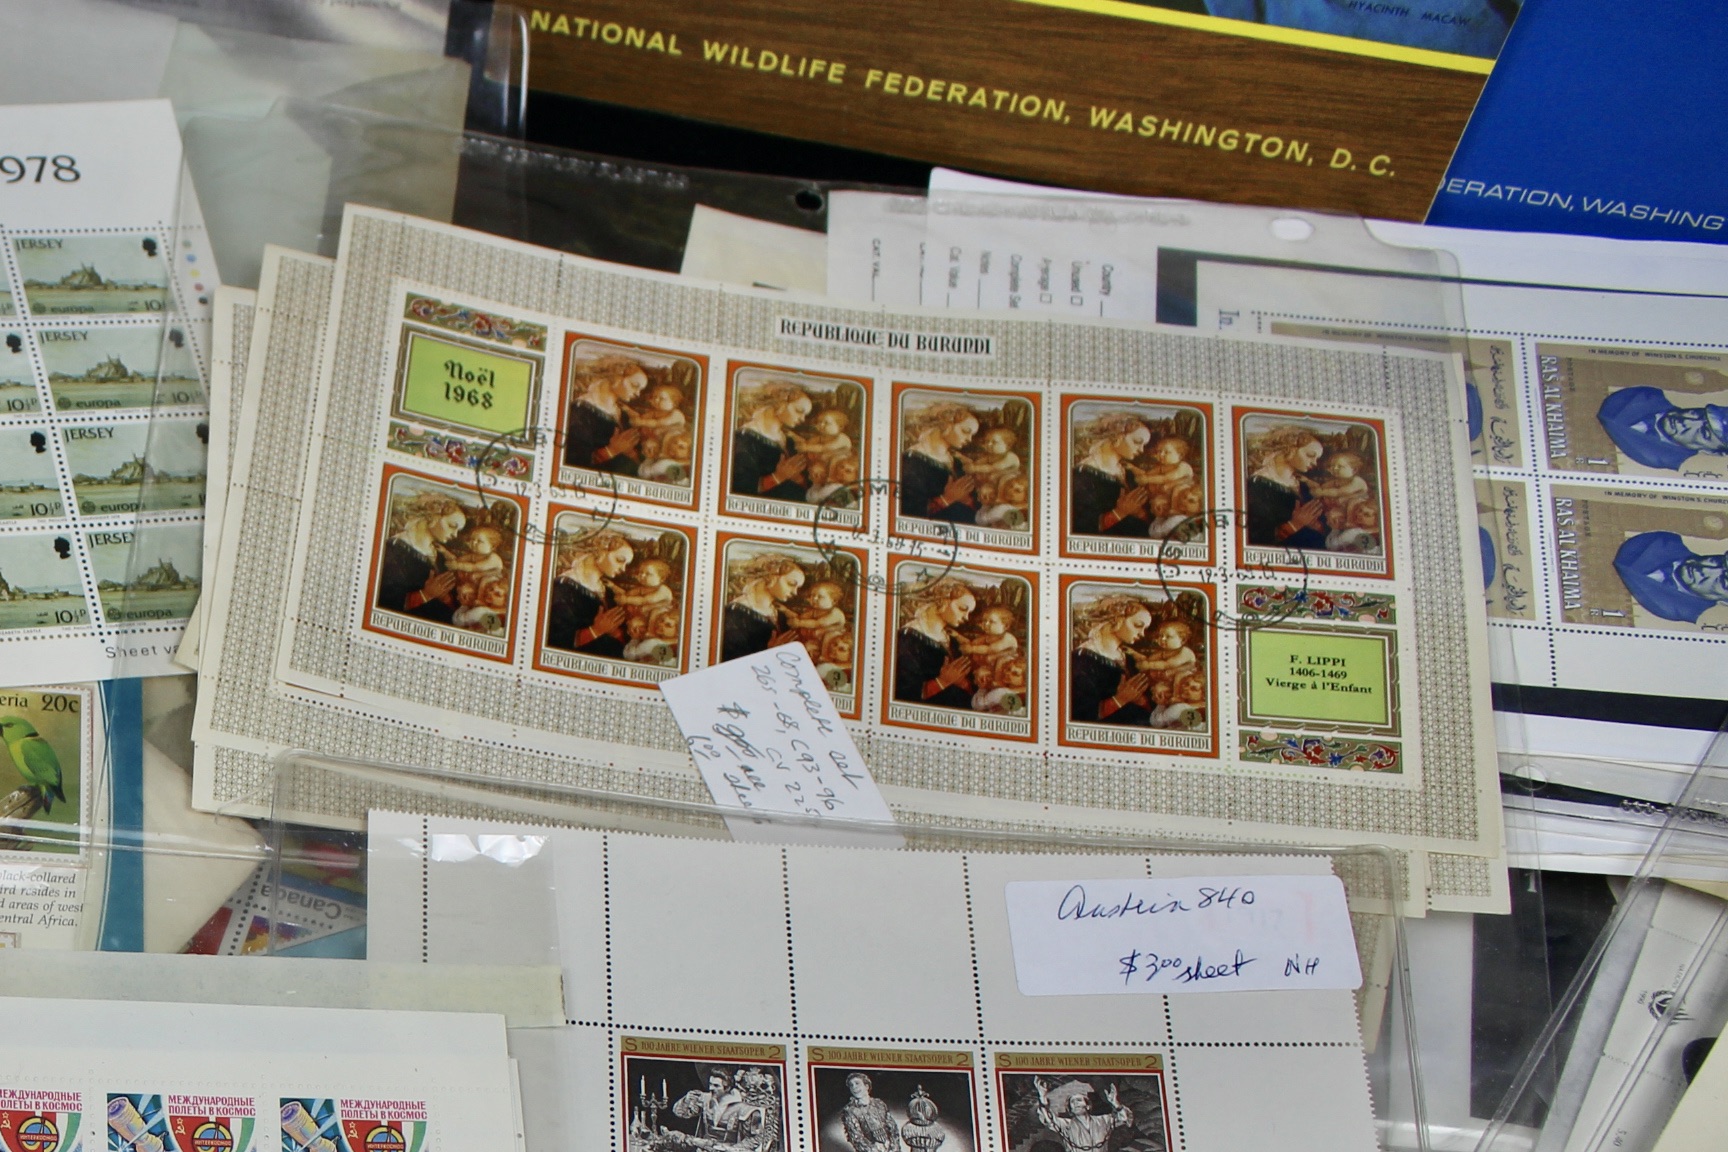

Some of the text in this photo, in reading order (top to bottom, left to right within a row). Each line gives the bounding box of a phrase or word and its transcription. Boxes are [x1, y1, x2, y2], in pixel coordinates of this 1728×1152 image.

[1421, 12, 1470, 28] MACAW
[530, 9, 1397, 178] NATIONAL WILDLIFE FEDERATION, WASHINGTON, D. C.
[1583, 196, 1728, 231] WASHING
[16, 238, 63, 251] JERSEY
[780, 318, 993, 356] REPUBLIQUE DU BURUNDI
[444, 358, 496, 388] Noël
[1540, 355, 1558, 386] RAS
[444, 381, 494, 410] 1968
[1544, 403, 1567, 461] KHAIMA
[1555, 497, 1573, 528] RAS
[1559, 549, 1582, 610] KHAIMA
[105, 641, 159, 659] Sheet
[1289, 654, 1347, 668] F. LIPPI
[1265, 676, 1308, 693] Vierge
[1289, 667, 1348, 681] 1406-1469
[41, 693, 80, 714] 20c
[21, 885, 61, 899] resides
[64, 887, 77, 899] in
[1198, 886, 1256, 909] 840
[8, 900, 40, 911] areas
[42, 898, 56, 913] of
[37, 913, 79, 929] Africa.
[1174, 948, 1258, 984] sheet
[641, 1040, 656, 1051] 100
[657, 1041, 681, 1052] JAHRE
[683, 1043, 715, 1054] WIENER
[718, 1044, 766, 1057] STAATSOPER
[768, 1045, 781, 1059] 2
[340, 1098, 427, 1112] МЕЖДУНАРОДНЫЕ
